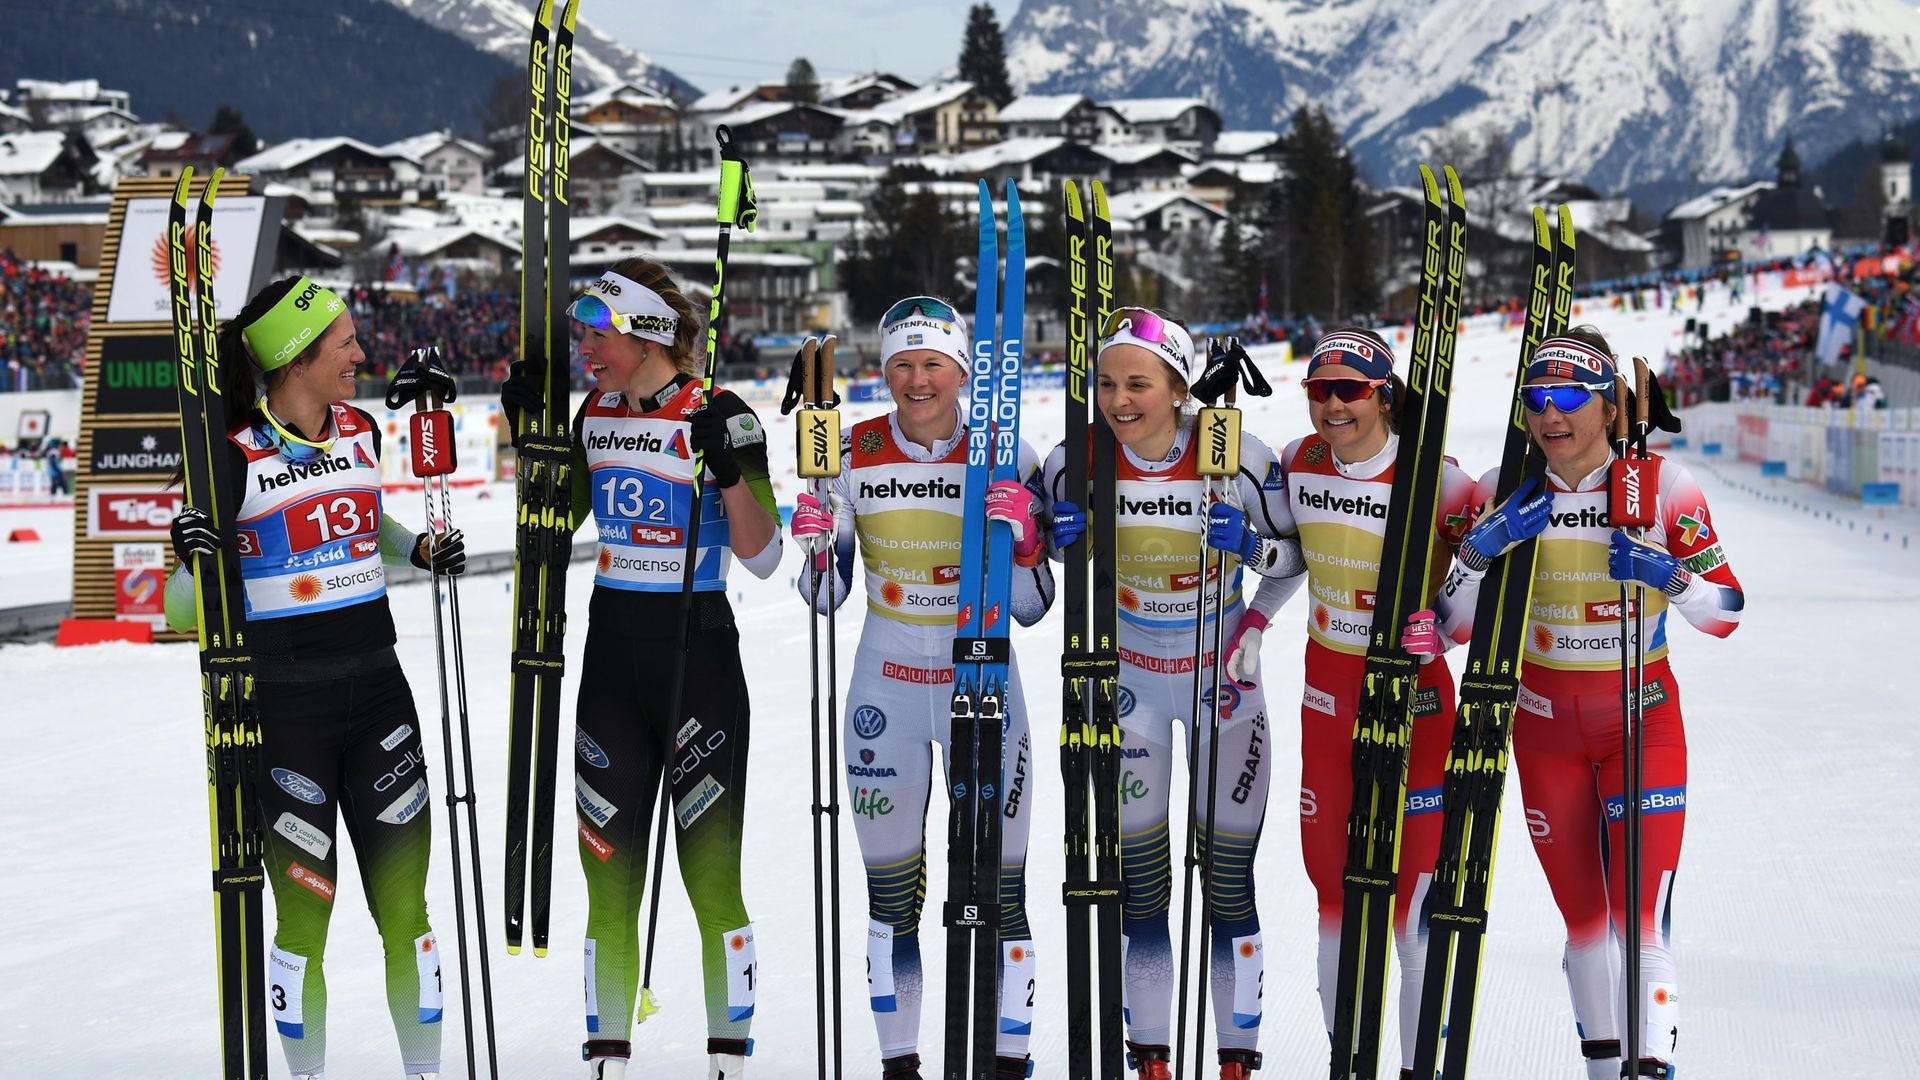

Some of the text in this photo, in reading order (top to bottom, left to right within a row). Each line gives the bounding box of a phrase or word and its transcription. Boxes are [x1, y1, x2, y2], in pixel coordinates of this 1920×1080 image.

[529, 40, 548, 202] FISCHER
[554, 44, 572, 206] FISCHER
[172, 221, 198, 396] FISCHER
[198, 221, 222, 395] FISCHER
[1411, 219, 1441, 396] FISCHER
[1434, 221, 1465, 397] FISCHER
[1070, 235, 1086, 404] FISCHER
[524, 442, 571, 452] FISCHER
[587, 431, 662, 453] helvetia
[258, 453, 352, 493] helvetia
[859, 478, 961, 499] helvetia
[1298, 485, 1387, 519] helvetia
[637, 528, 677, 543] Tirol
[901, 540, 962, 551] CHAMPIO
[1134, 554, 1200, 562] CHAMPIO
[906, 594, 960, 606] storae
[209, 655, 252, 664] FISCHER
[517, 659, 563, 668] FISCHER
[1063, 659, 1117, 668] FISCHER
[1366, 656, 1412, 666] FISCHER
[883, 662, 953, 684] BAUHA
[1462, 681, 1513, 691] FISCHER
[848, 764, 898, 778] SCANIA
[1231, 731, 1264, 805] CRAFT
[279, 773, 318, 801] Ford
[1003, 752, 1029, 819] CRAFT
[222, 875, 263, 885] FISCHER
[1344, 875, 1390, 886] FISCHER
[1066, 889, 1119, 897] FISCHER
[1431, 912, 1482, 924] FISCHER
